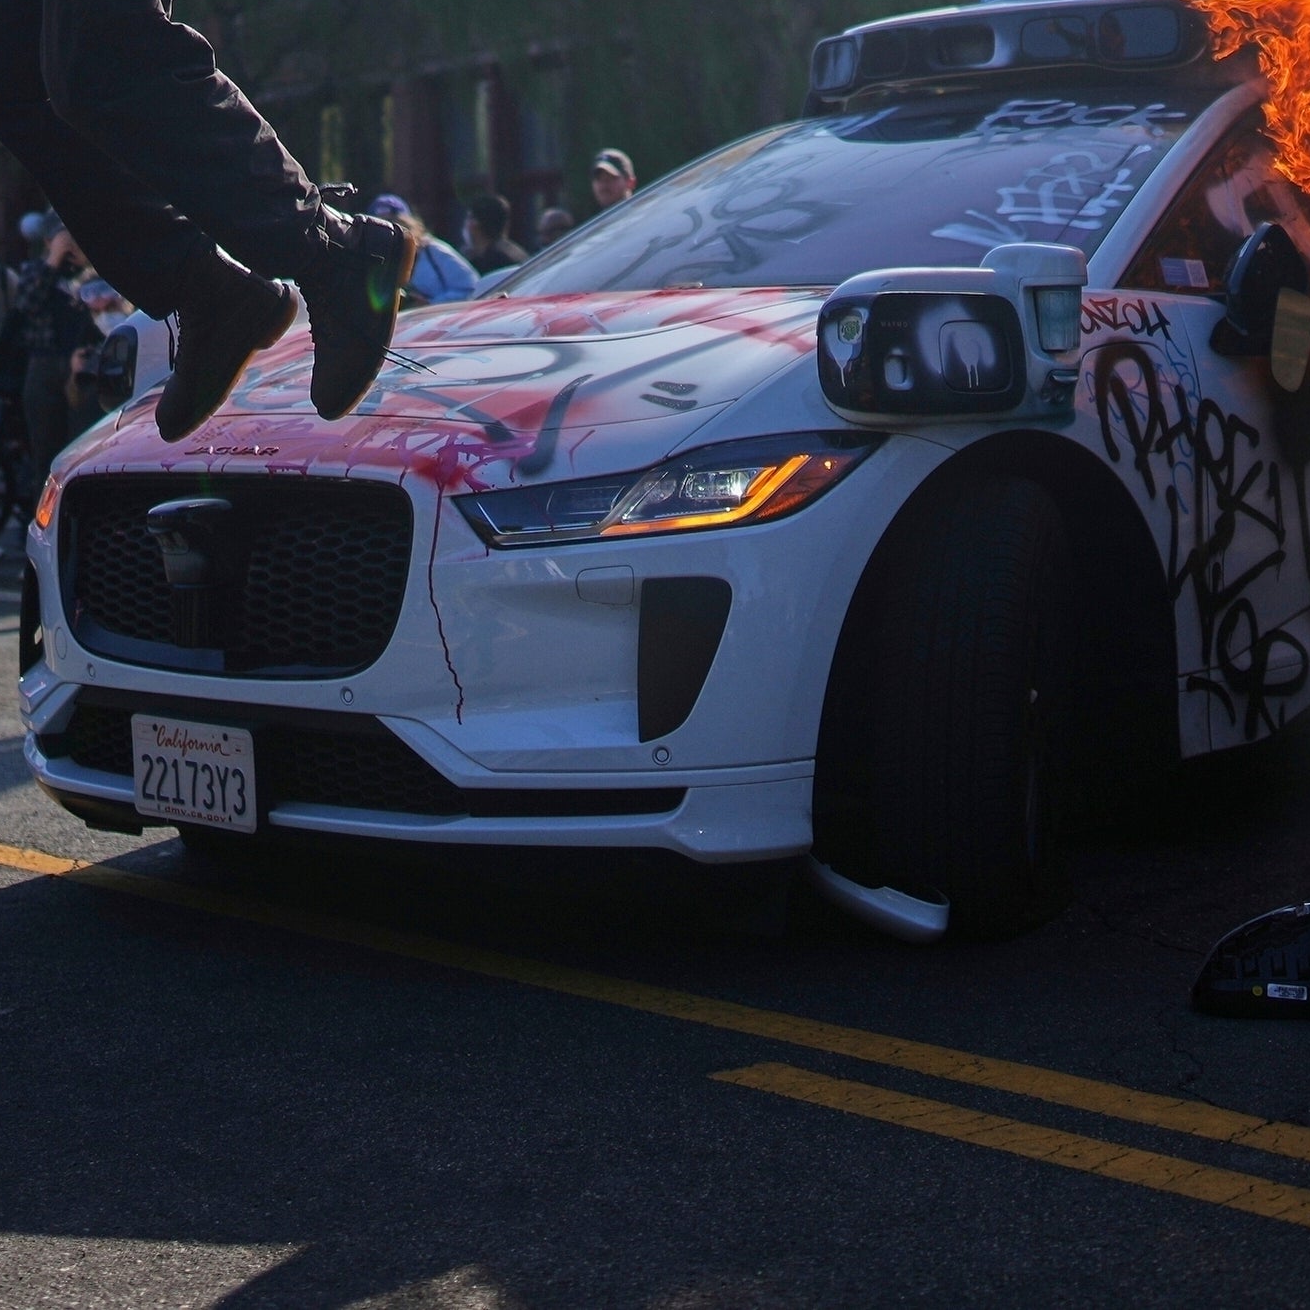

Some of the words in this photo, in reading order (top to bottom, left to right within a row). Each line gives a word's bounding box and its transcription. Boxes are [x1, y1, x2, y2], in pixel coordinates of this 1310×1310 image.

[184, 445, 280, 456] JAGUAR
[157, 725, 231, 757] California
[142, 753, 246, 816] 22173Y3
[164, 805, 227, 823] dmv.ca.gov
